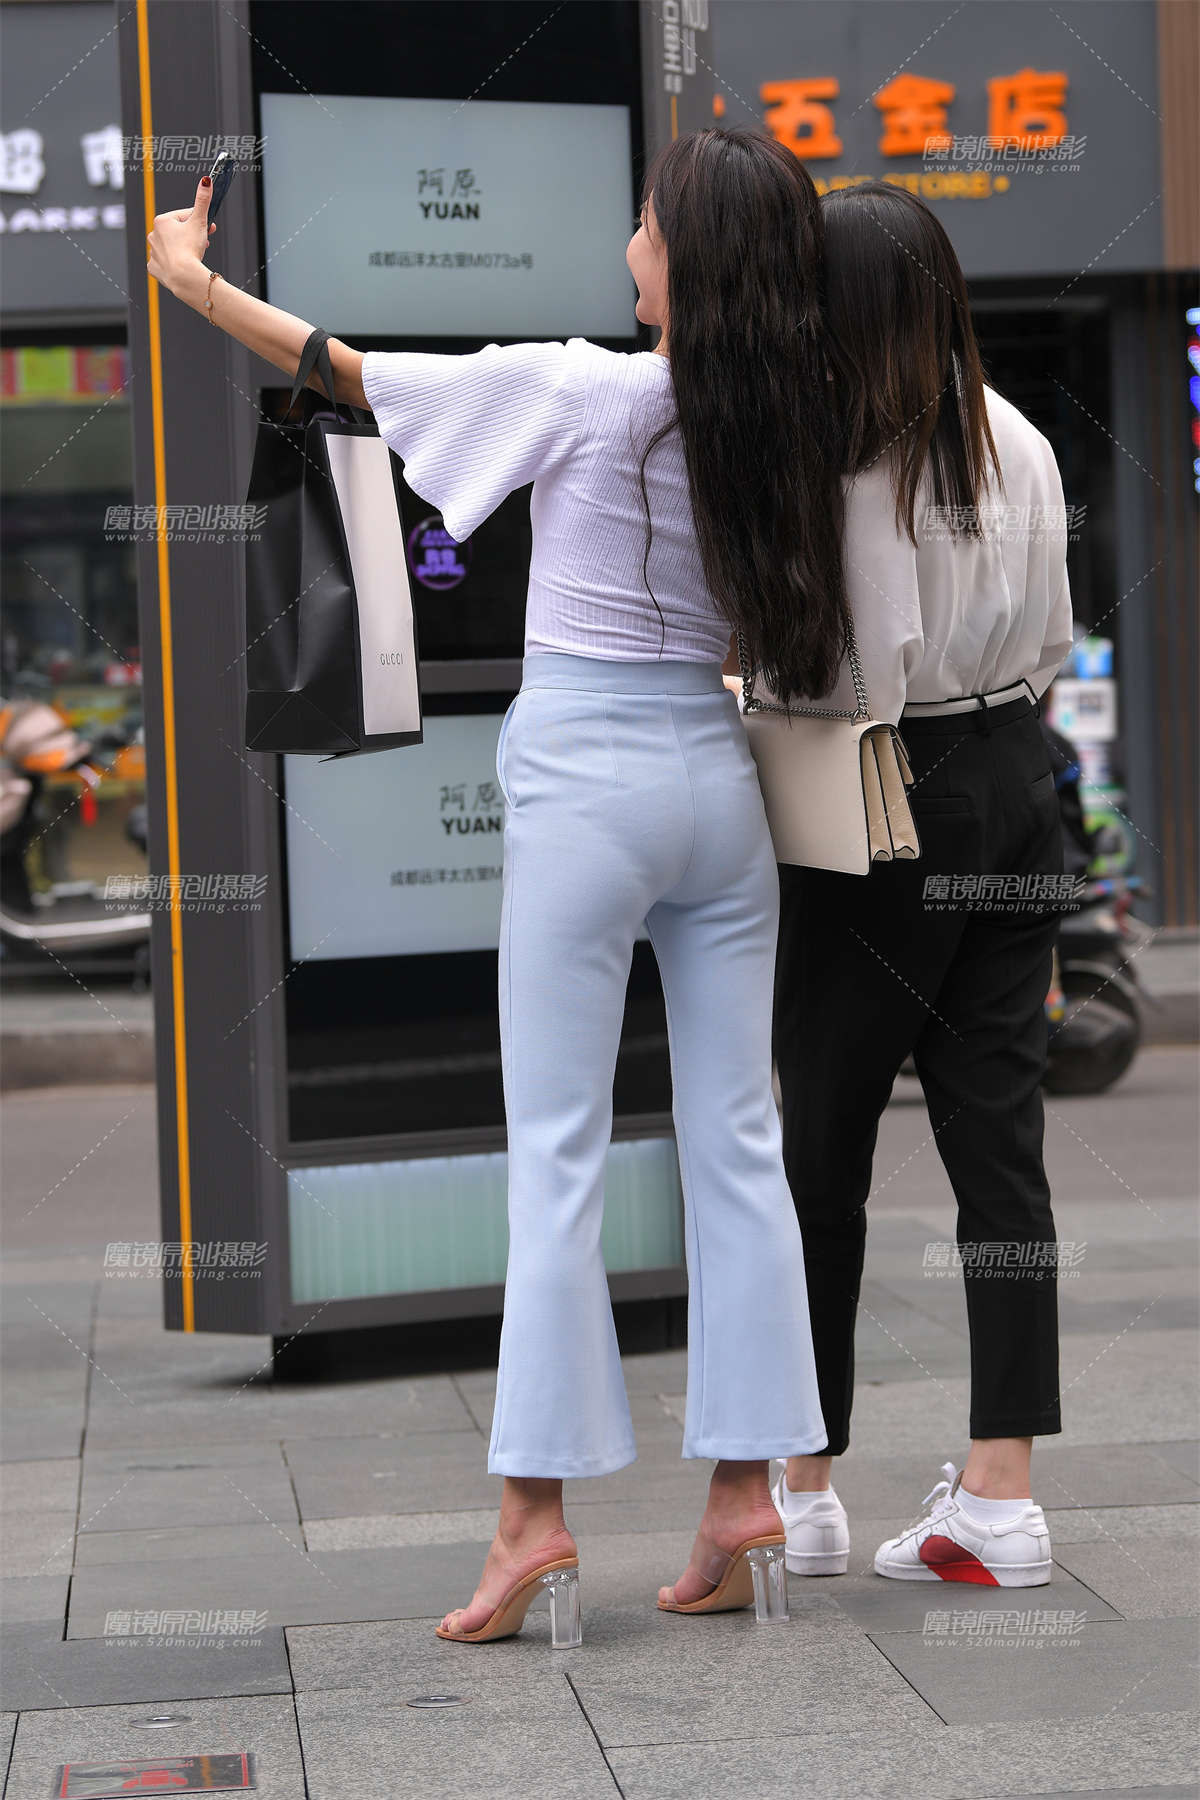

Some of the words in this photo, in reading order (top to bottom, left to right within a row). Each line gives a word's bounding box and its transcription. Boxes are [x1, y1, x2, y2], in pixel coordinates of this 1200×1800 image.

[759, 68, 1069, 160] 五金店
[419, 202, 481, 220] YUAN
[380, 652, 404, 666] GUCCI
[441, 815, 502, 836] YUAN
